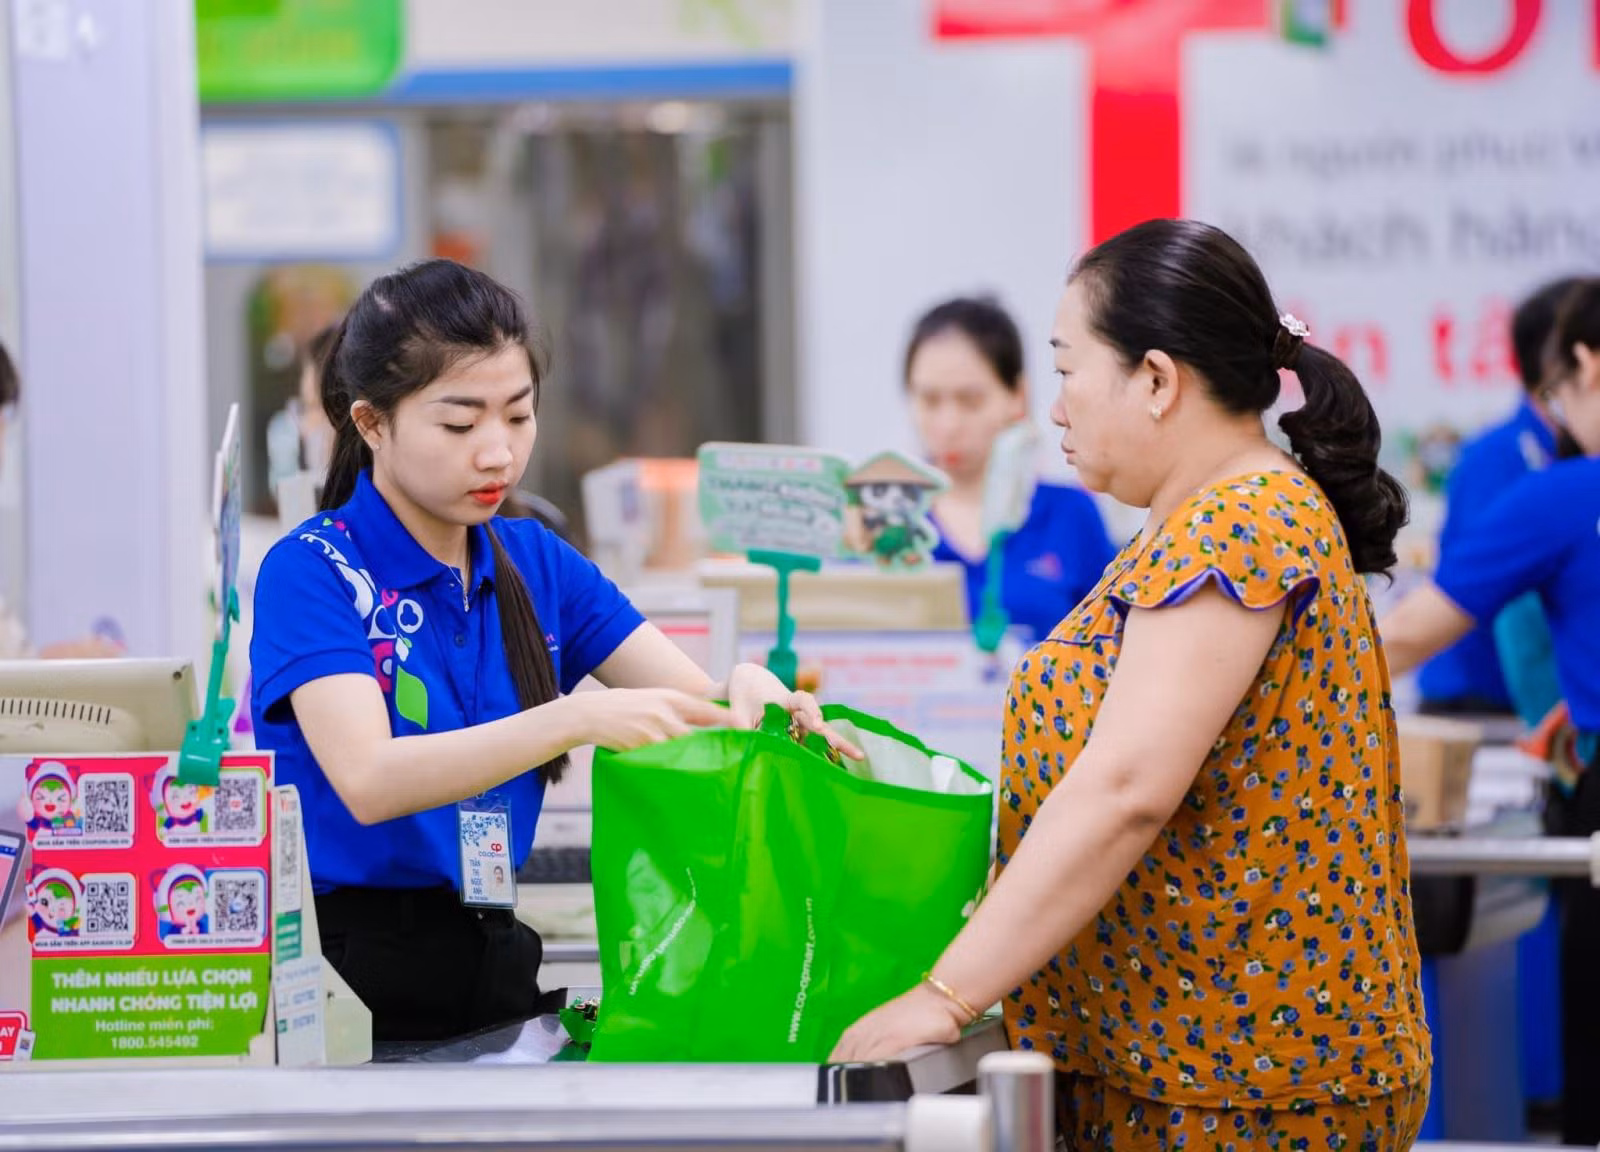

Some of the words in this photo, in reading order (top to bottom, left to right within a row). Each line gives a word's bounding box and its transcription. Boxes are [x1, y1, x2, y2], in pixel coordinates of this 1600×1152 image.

[52, 968, 101, 988] THÊM
[163, 969, 199, 989] LỰA
[201, 967, 253, 988] CHỌN
[51, 996, 115, 1013] NHANH
[119, 992, 182, 1011] CHÓNG
[186, 989, 225, 1013] TIỆN
[229, 991, 259, 1013] LỢI
[95, 1019, 145, 1032] Hotline
[187, 1018, 214, 1032] phí:
[111, 1035, 199, 1050] 1800.545492
